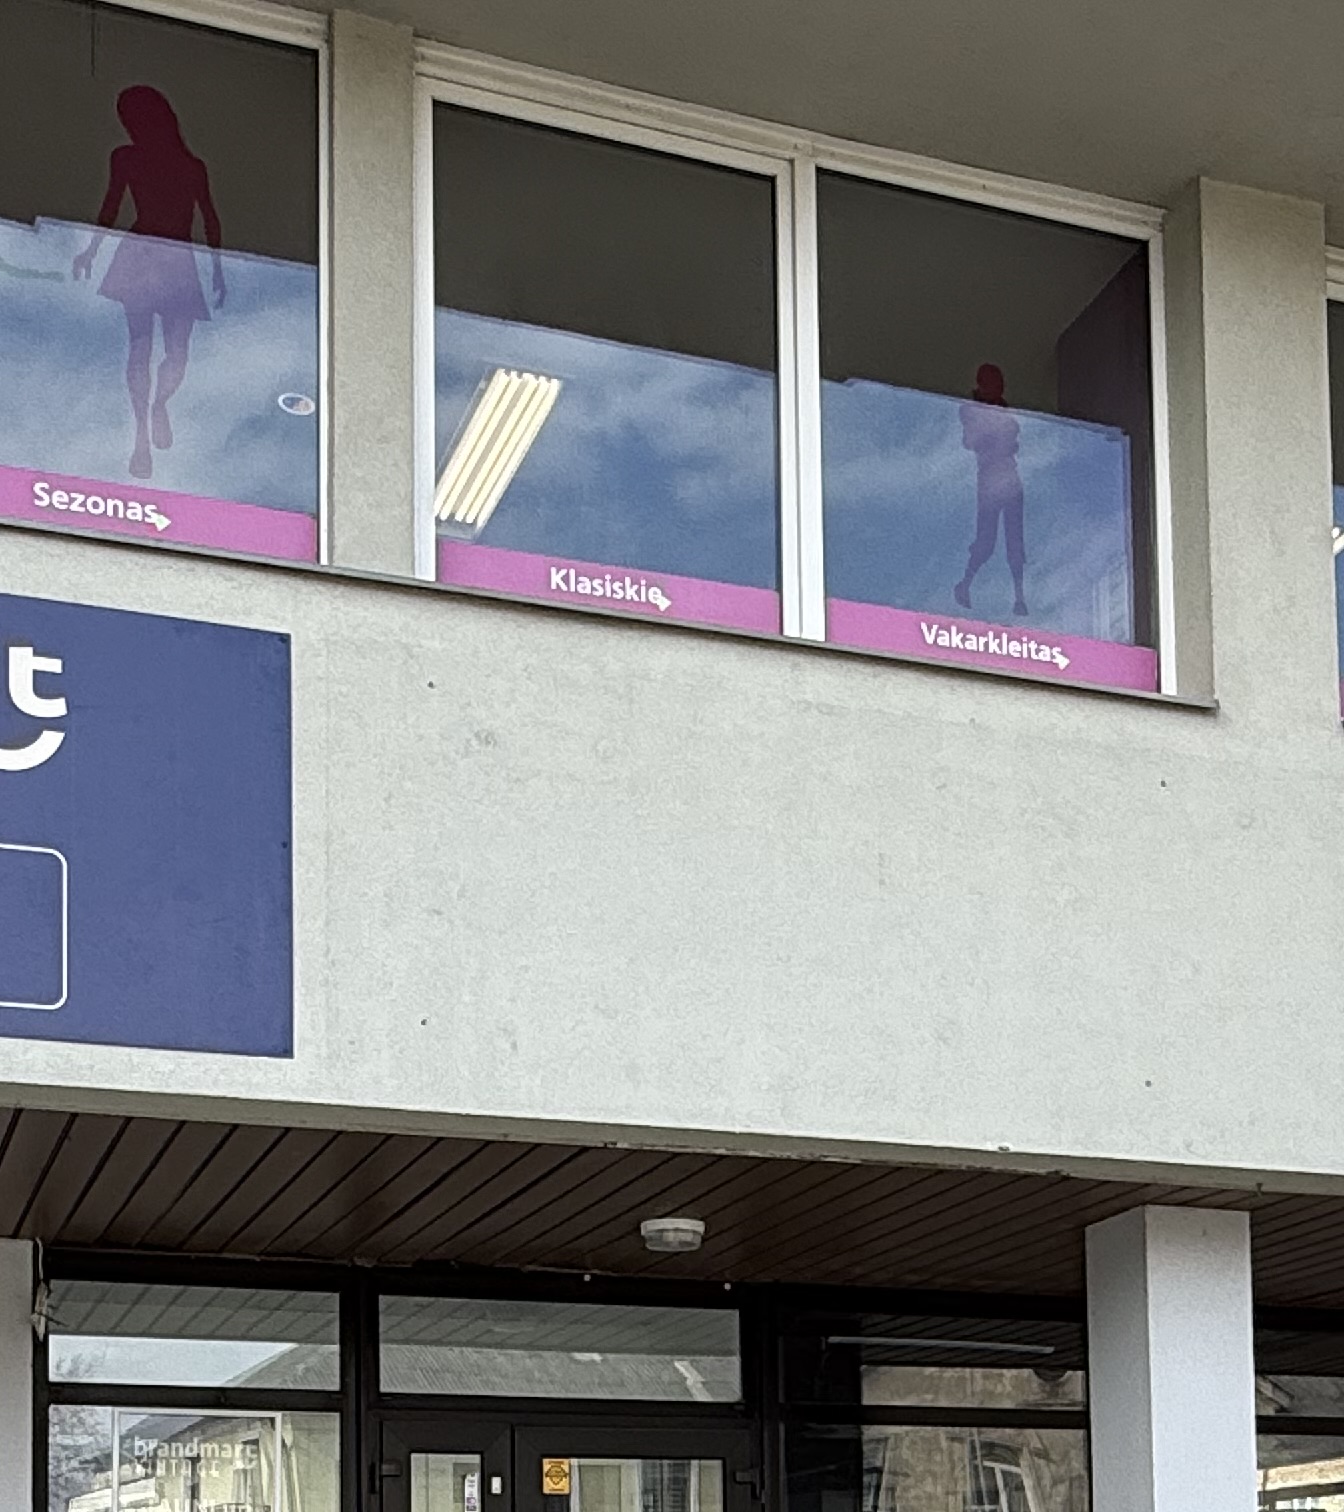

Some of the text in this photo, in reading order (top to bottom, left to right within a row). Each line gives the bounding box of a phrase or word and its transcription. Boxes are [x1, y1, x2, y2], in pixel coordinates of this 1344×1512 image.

[33, 482, 158, 524] Sezonas
[550, 567, 662, 604] Klasiskie
[920, 622, 1062, 663] Vakarkleitas
